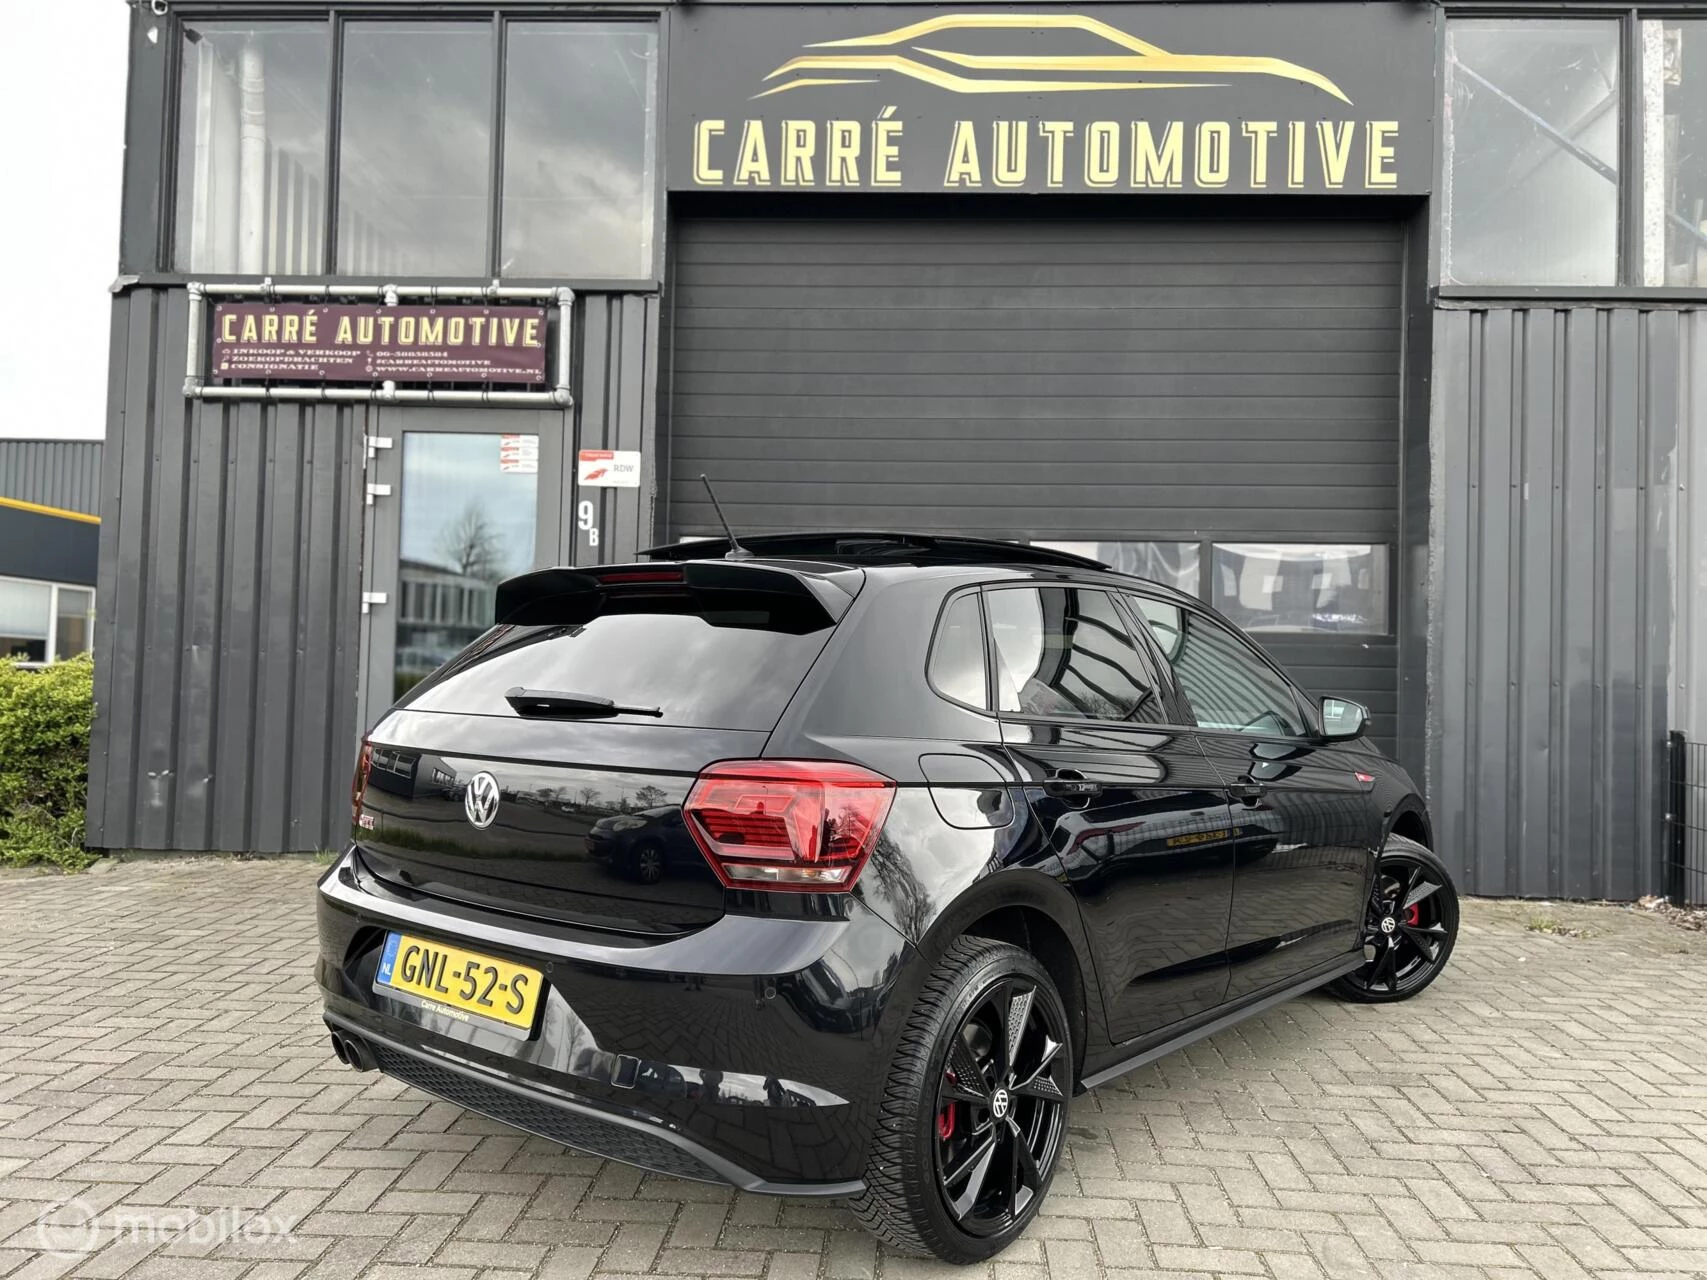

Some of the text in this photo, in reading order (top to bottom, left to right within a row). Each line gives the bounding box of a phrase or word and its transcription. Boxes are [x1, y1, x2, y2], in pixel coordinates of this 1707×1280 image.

[693, 106, 1399, 188] CARRÉ AUTOMOTIVE
[222, 309, 540, 346] CARRÉ AUTOMOTIVE
[231, 355, 354, 364] ZOEKOPDRACHTEN
[298, 349, 361, 357] VERKOOP
[230, 362, 319, 371] CONSIGNATIE
[613, 464, 634, 473] RDW
[382, 962, 392, 976] NL
[401, 945, 529, 1015] GNL-52-S
[437, 1003, 470, 1022] Automotive
